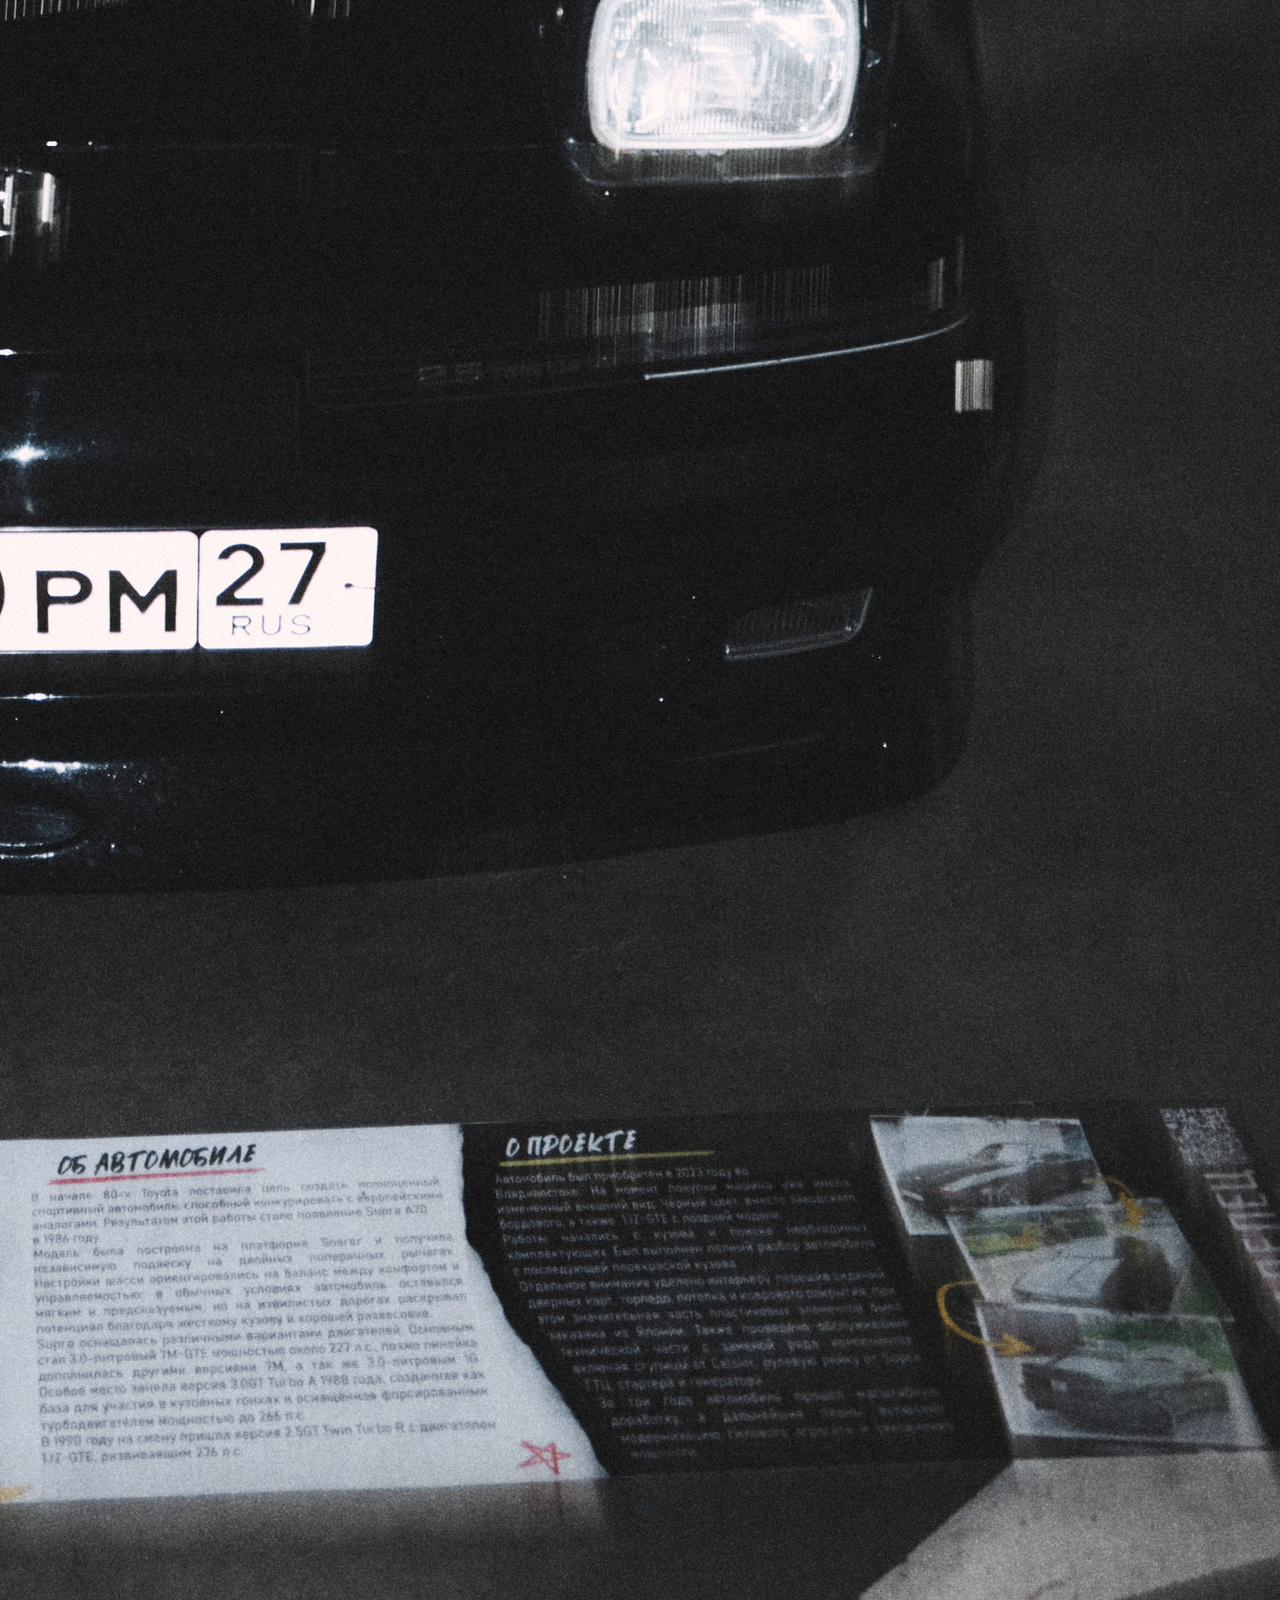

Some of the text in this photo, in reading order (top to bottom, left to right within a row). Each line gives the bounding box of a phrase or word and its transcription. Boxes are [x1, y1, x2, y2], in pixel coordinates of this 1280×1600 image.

[216, 542, 326, 606] 27
[232, 614, 311, 636] RUS
[527, 1129, 637, 1156] ПРОЕКТЕ
[57, 1143, 257, 1176] ОБ АВТОМОБИЛЕ
